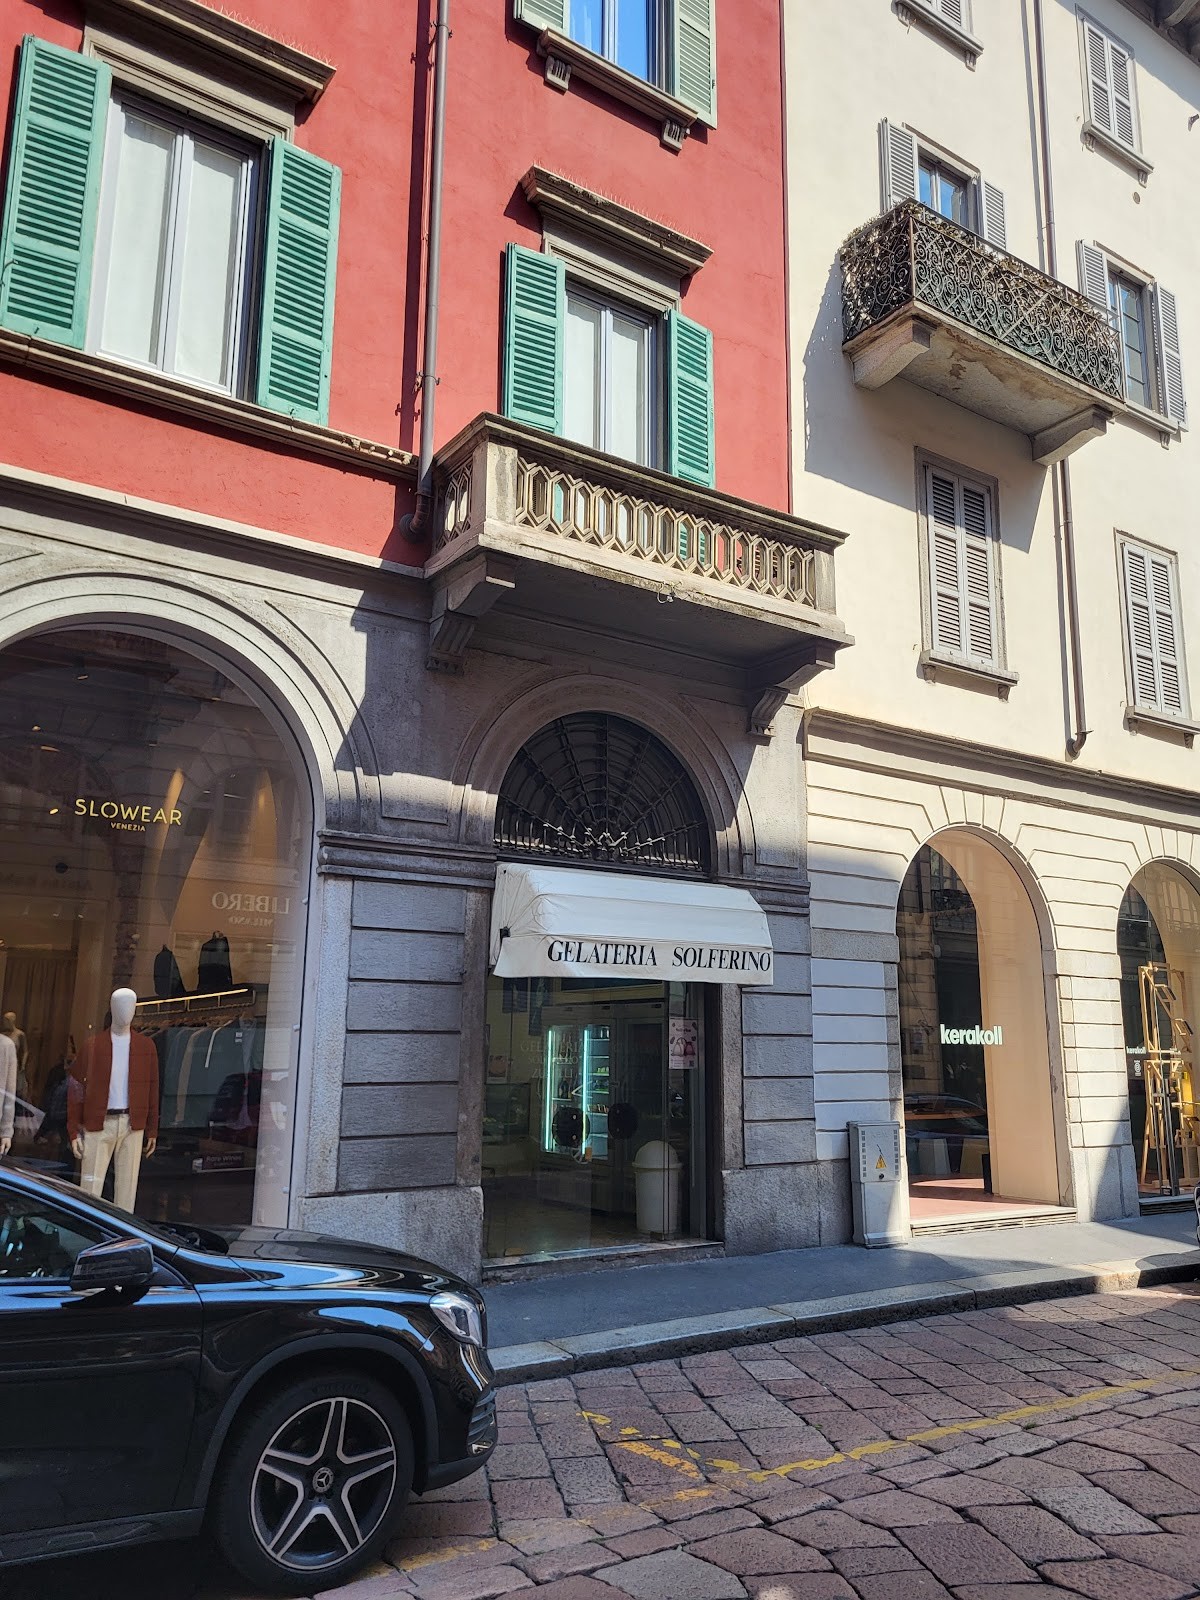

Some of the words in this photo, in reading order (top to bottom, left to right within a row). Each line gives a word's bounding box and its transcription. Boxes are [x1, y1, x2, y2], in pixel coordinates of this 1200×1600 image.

[74, 799, 182, 825] SLOWEAR
[110, 822, 146, 832] VENEZIA
[547, 939, 658, 967] GELATERIA
[672, 946, 771, 972] SOLFERINO
[939, 1023, 1003, 1046] kerakoll
